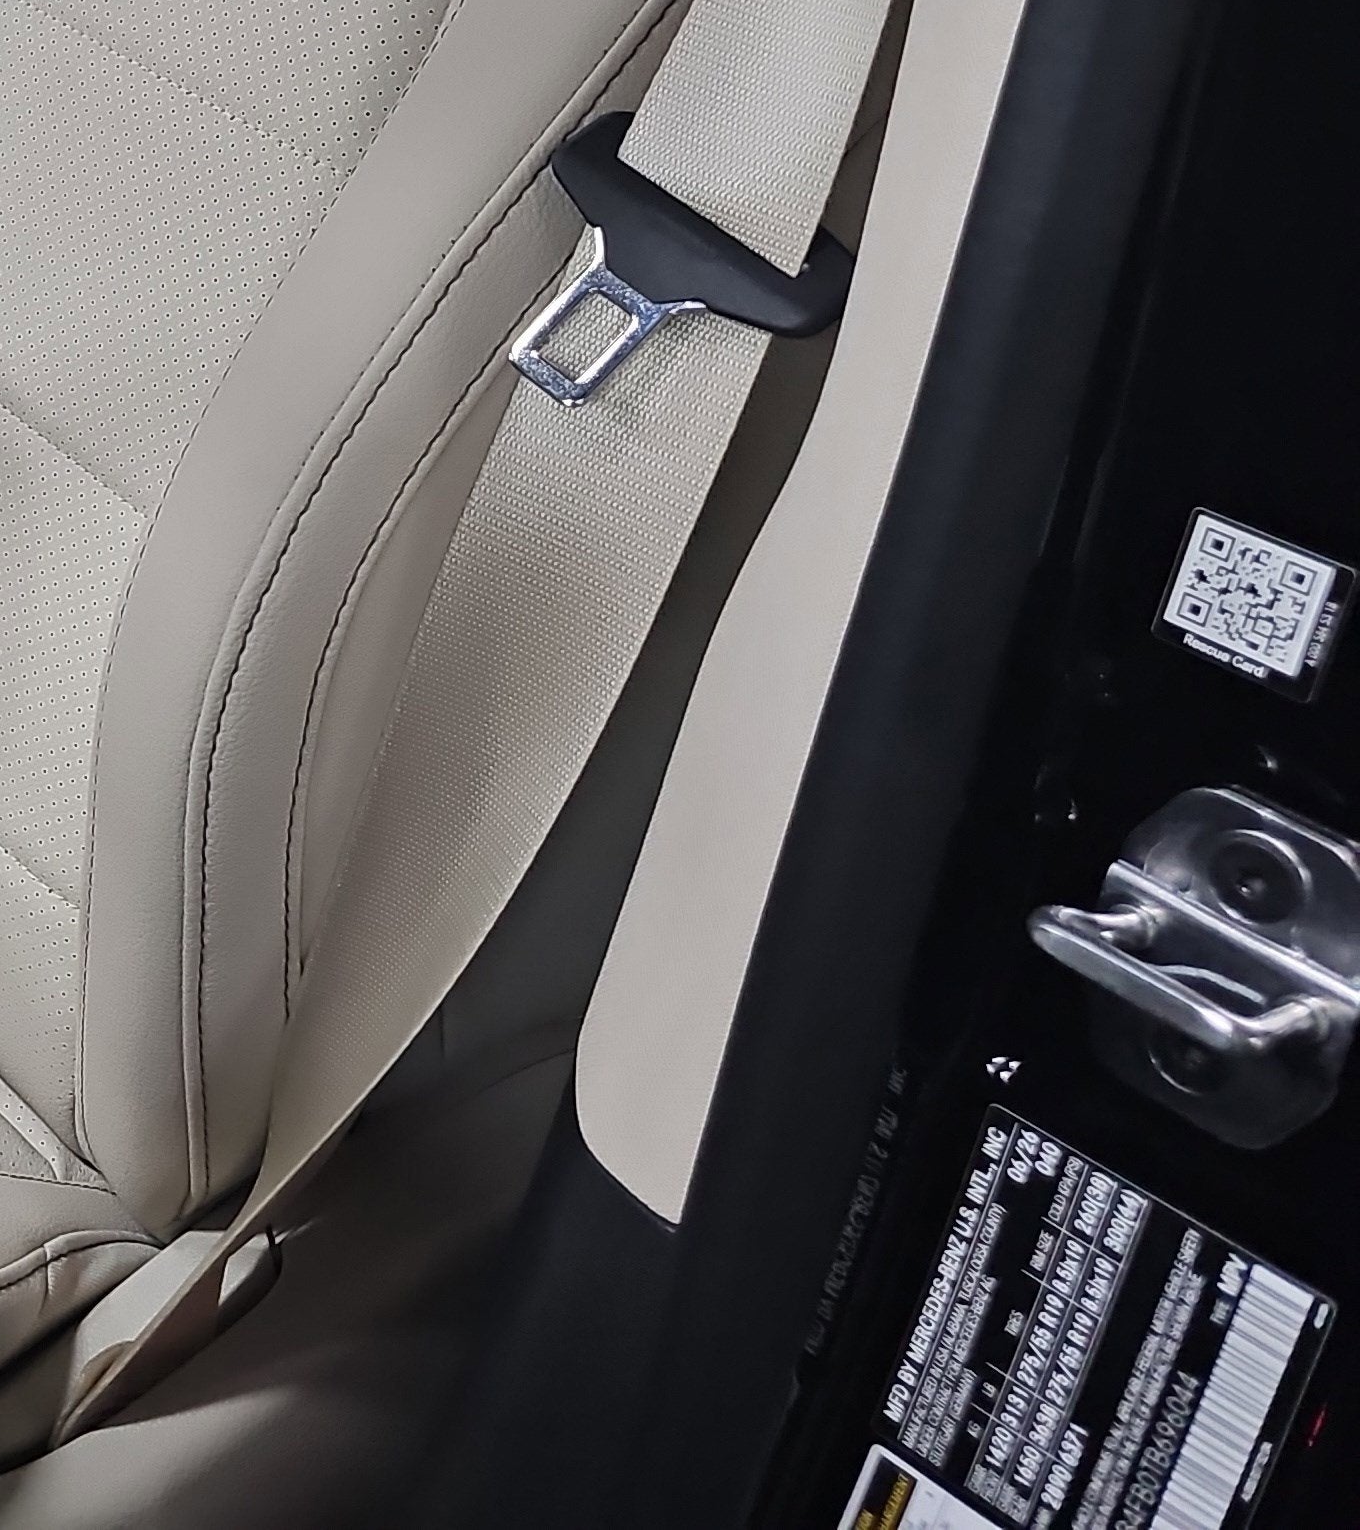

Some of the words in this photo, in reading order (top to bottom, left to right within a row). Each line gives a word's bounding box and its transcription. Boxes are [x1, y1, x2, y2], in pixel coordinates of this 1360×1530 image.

[1183, 634, 1229, 663] Rescue
[1233, 654, 1265, 678] Card
[981, 1127, 1008, 1160] INC
[1007, 1129, 1040, 1183] 06/26
[1032, 1142, 1062, 1176] 040
[1048, 1195, 1067, 1222] COLD
[1058, 1177, 1075, 1197] KPA
[1074, 1172, 1116, 1239] 260(38)
[953, 1207, 980, 1238] U.S.
[980, 1203, 1007, 1244] COUNTY)
[1037, 1230, 1054, 1252] SIZE
[1103, 1189, 1144, 1256] 300(44)
[1177, 1228, 1201, 1266] SAFETY
[958, 1243, 990, 1301] TUSCALOOSA
[978, 1274, 996, 1293] AG
[1217, 1253, 1248, 1297] MPV
[906, 1234, 968, 1365] MERCEDES-BENZ
[952, 1285, 991, 1363] MERCEDES-BENZ
[1004, 1310, 1024, 1336] TIRES
[1017, 1325, 1056, 1390] 275/55
[1038, 1294, 1064, 1329] R19
[897, 1359, 918, 1386] BY
[930, 1364, 943, 1379] IN
[933, 1347, 950, 1367] USA
[945, 1360, 962, 1381] FOR
[1045, 1343, 1086, 1409] 275/55
[1067, 1312, 1094, 1348] R19
[883, 1384, 911, 1422] MFD
[928, 1377, 954, 1426] CONTRACT
[982, 1382, 997, 1398] LB
[1001, 1386, 1032, 1430] 3131
[902, 1375, 938, 1449] MANUFACTURED
[928, 1415, 956, 1466] STUTTGART
[947, 1368, 977, 1421] (GERMANY)
[967, 1421, 982, 1438] KG
[915, 1424, 936, 1457] UNDER
[985, 1427, 1017, 1467] 1420
[1014, 1446, 1045, 1487] 1650
